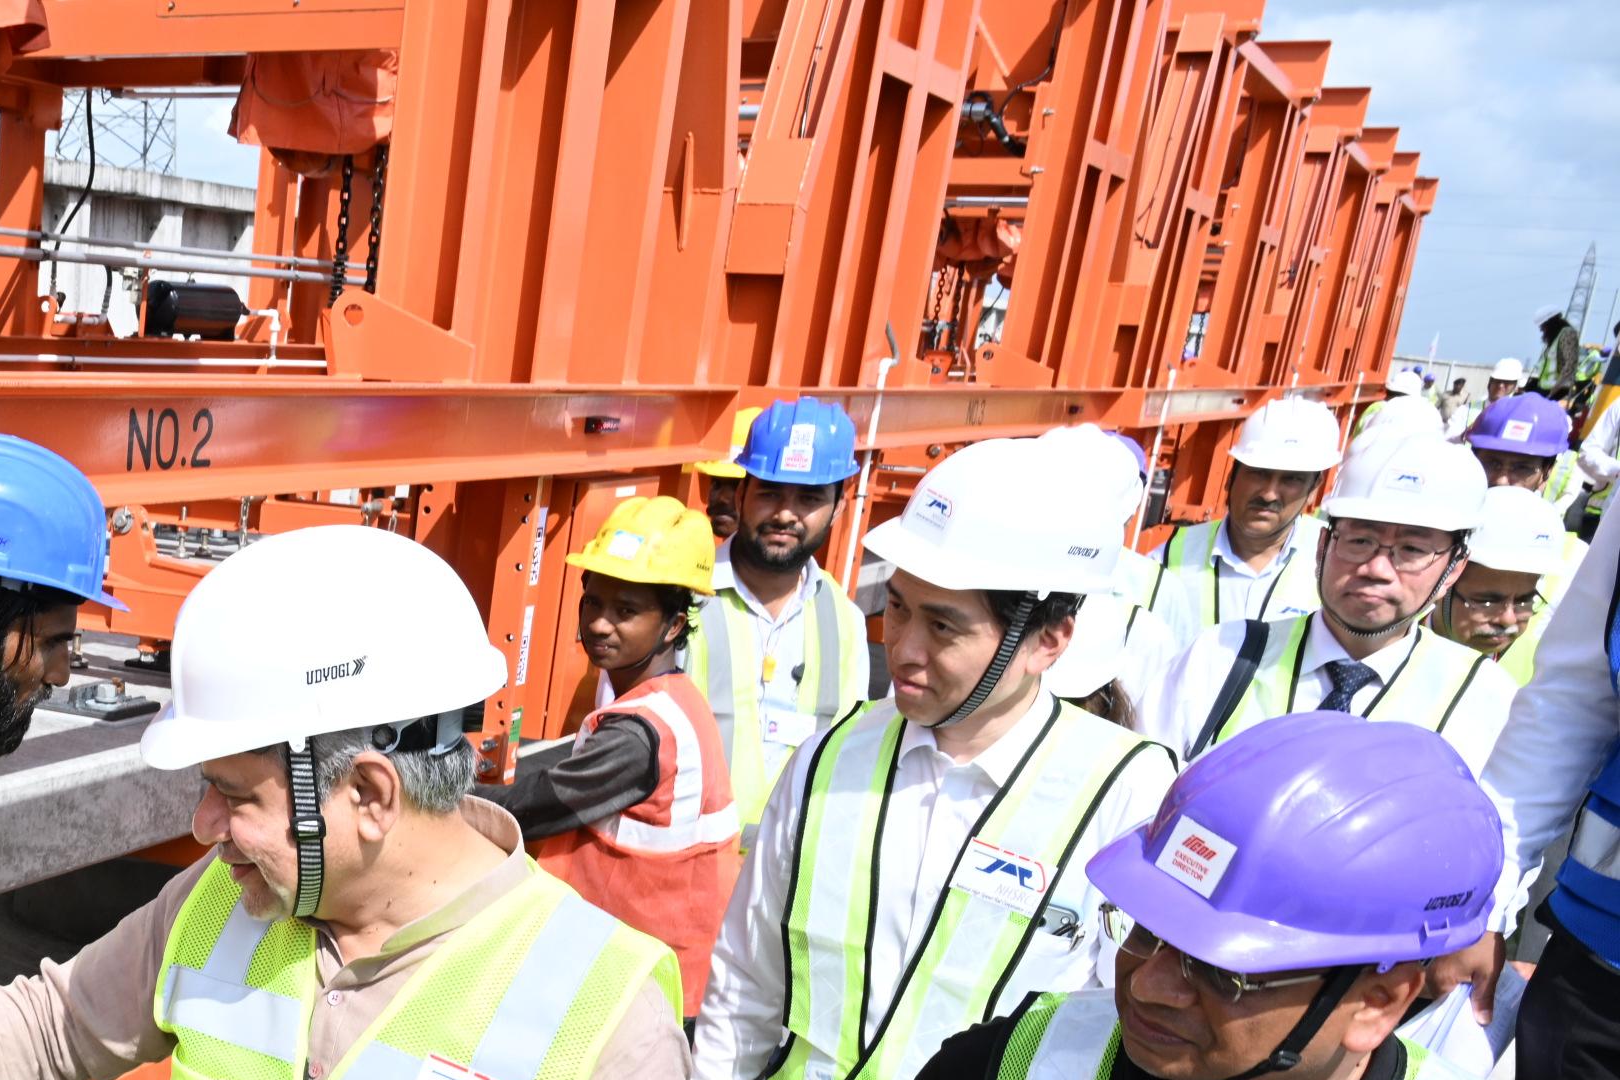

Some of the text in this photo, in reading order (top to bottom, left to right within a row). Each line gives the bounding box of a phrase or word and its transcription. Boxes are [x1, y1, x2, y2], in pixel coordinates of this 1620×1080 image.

[126, 407, 214, 472] NO.2
[306, 661, 350, 685] UDYOGI
[1172, 858, 1203, 882] DIRECTOR
[1175, 850, 1209, 875] EXECUTIVE
